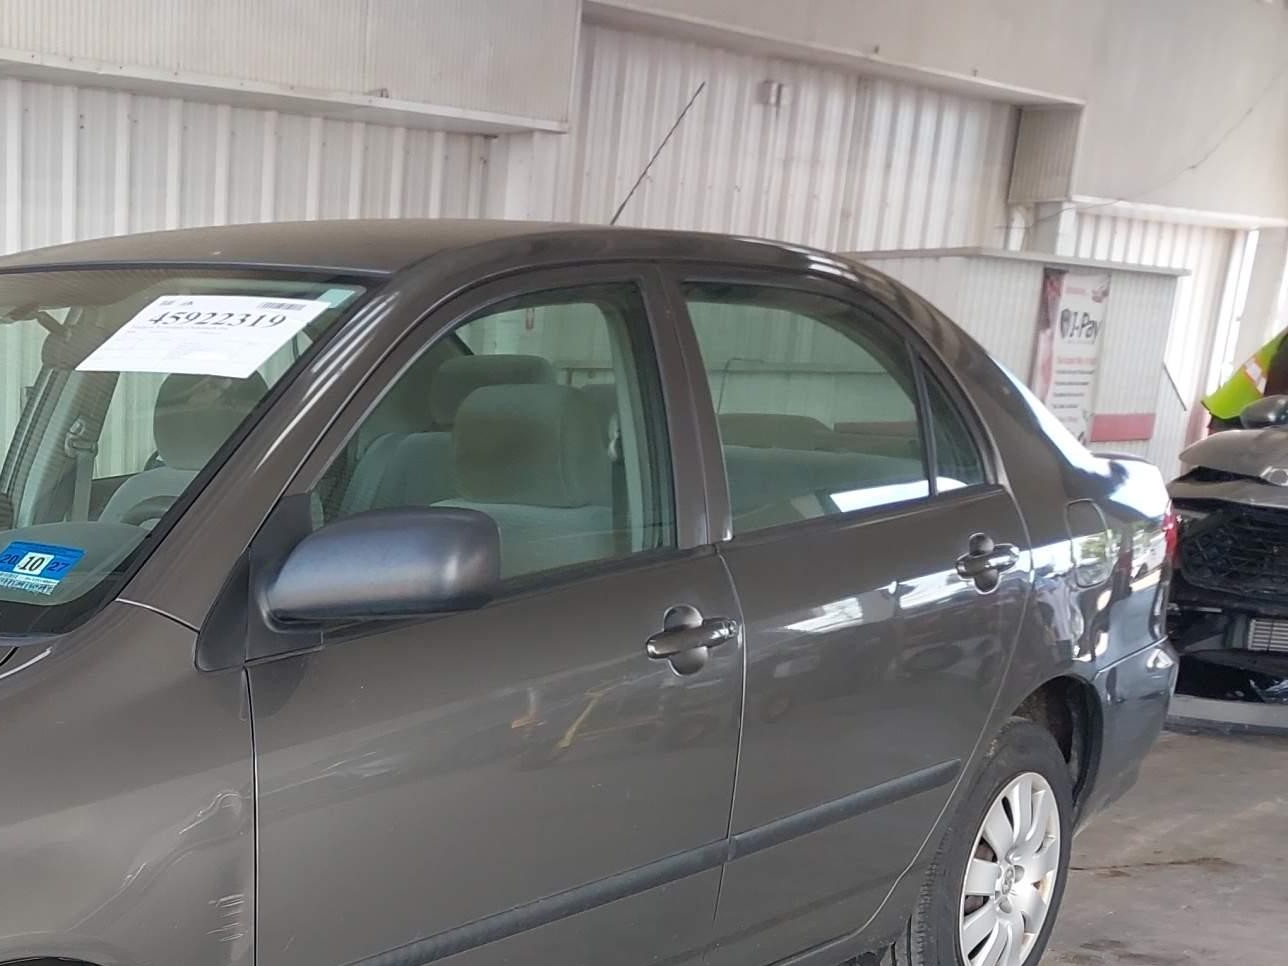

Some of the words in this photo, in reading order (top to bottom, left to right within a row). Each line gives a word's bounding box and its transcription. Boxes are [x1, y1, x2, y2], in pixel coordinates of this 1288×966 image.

[148, 311, 287, 328] 45922319
[0, 553, 20, 565] 20
[19, 555, 45, 572] 10
[48, 560, 70, 573] 27
